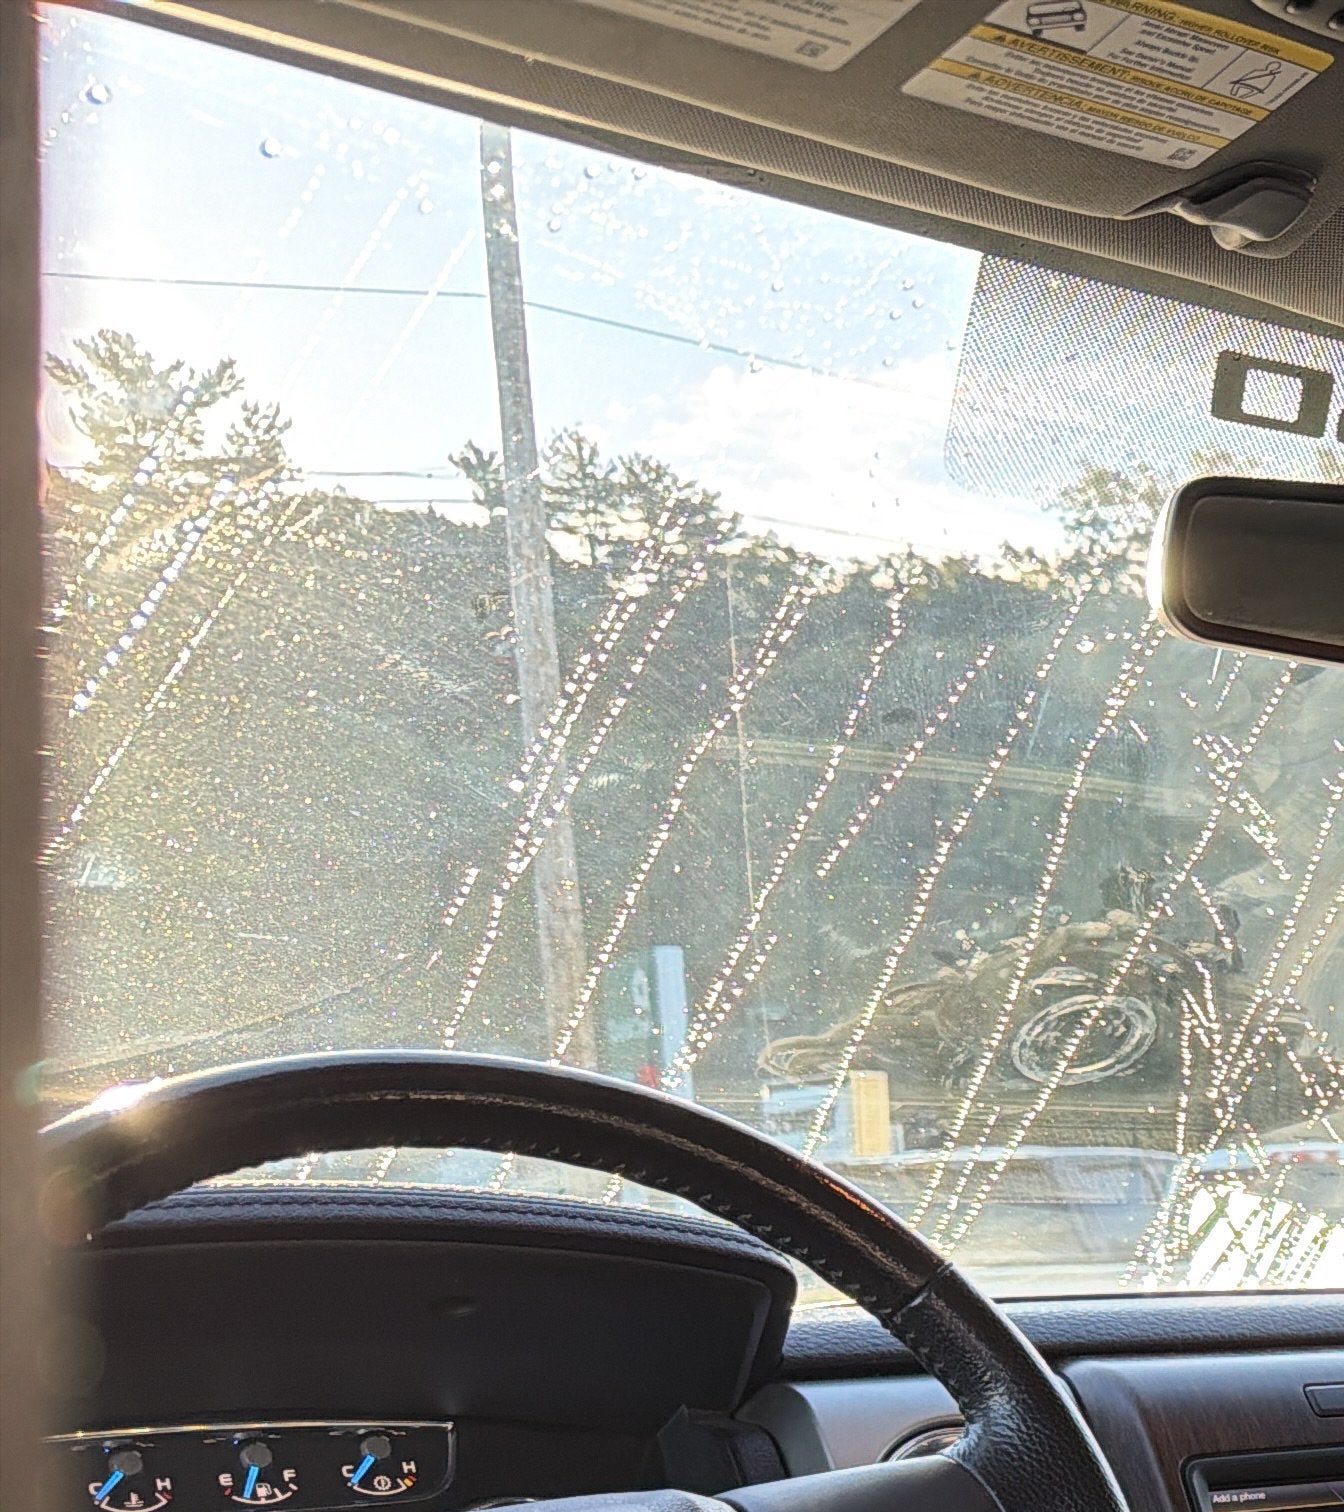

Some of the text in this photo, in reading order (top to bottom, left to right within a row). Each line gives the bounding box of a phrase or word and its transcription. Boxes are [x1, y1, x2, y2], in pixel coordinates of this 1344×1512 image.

[341, 1461, 417, 1478] C H
[155, 1477, 172, 1491] H
[218, 1469, 297, 1487] E F
[1213, 1494, 1231, 1504] Add
[1240, 1492, 1266, 1503] phone
